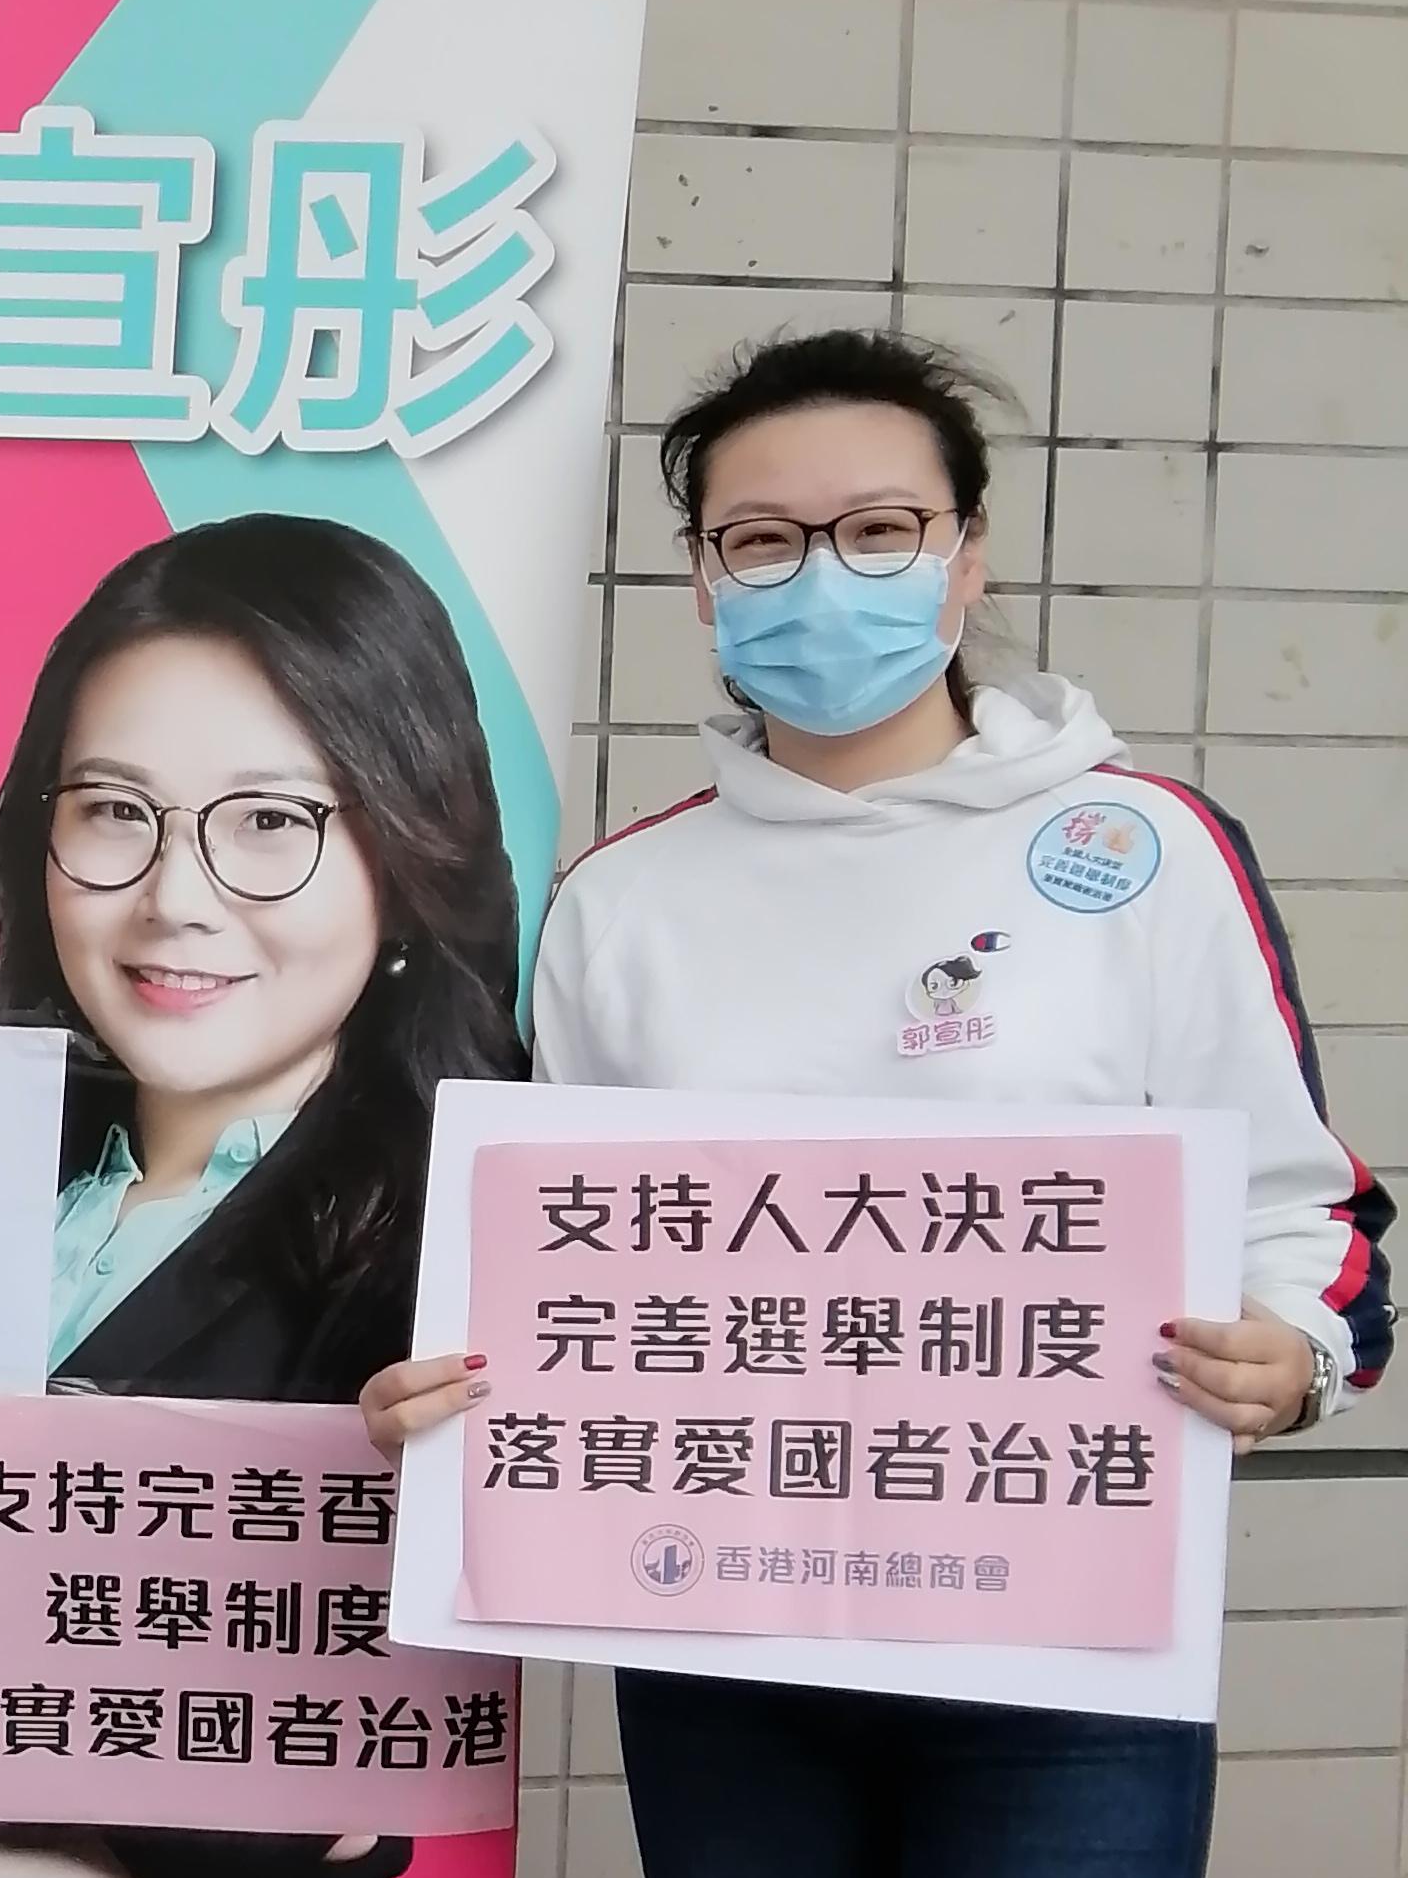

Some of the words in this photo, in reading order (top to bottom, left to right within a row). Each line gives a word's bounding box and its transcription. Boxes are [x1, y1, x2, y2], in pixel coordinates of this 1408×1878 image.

[902, 1015, 997, 1050] 郭宣彤
[538, 1170, 1108, 1256] 支持人大決定
[536, 1294, 1107, 1379] 完善選舉制度
[482, 1412, 1157, 1510] 落實愛國者治港
[715, 1544, 1012, 1594] 香港河南總商會
[45, 1571, 392, 1658] 選舉制度
